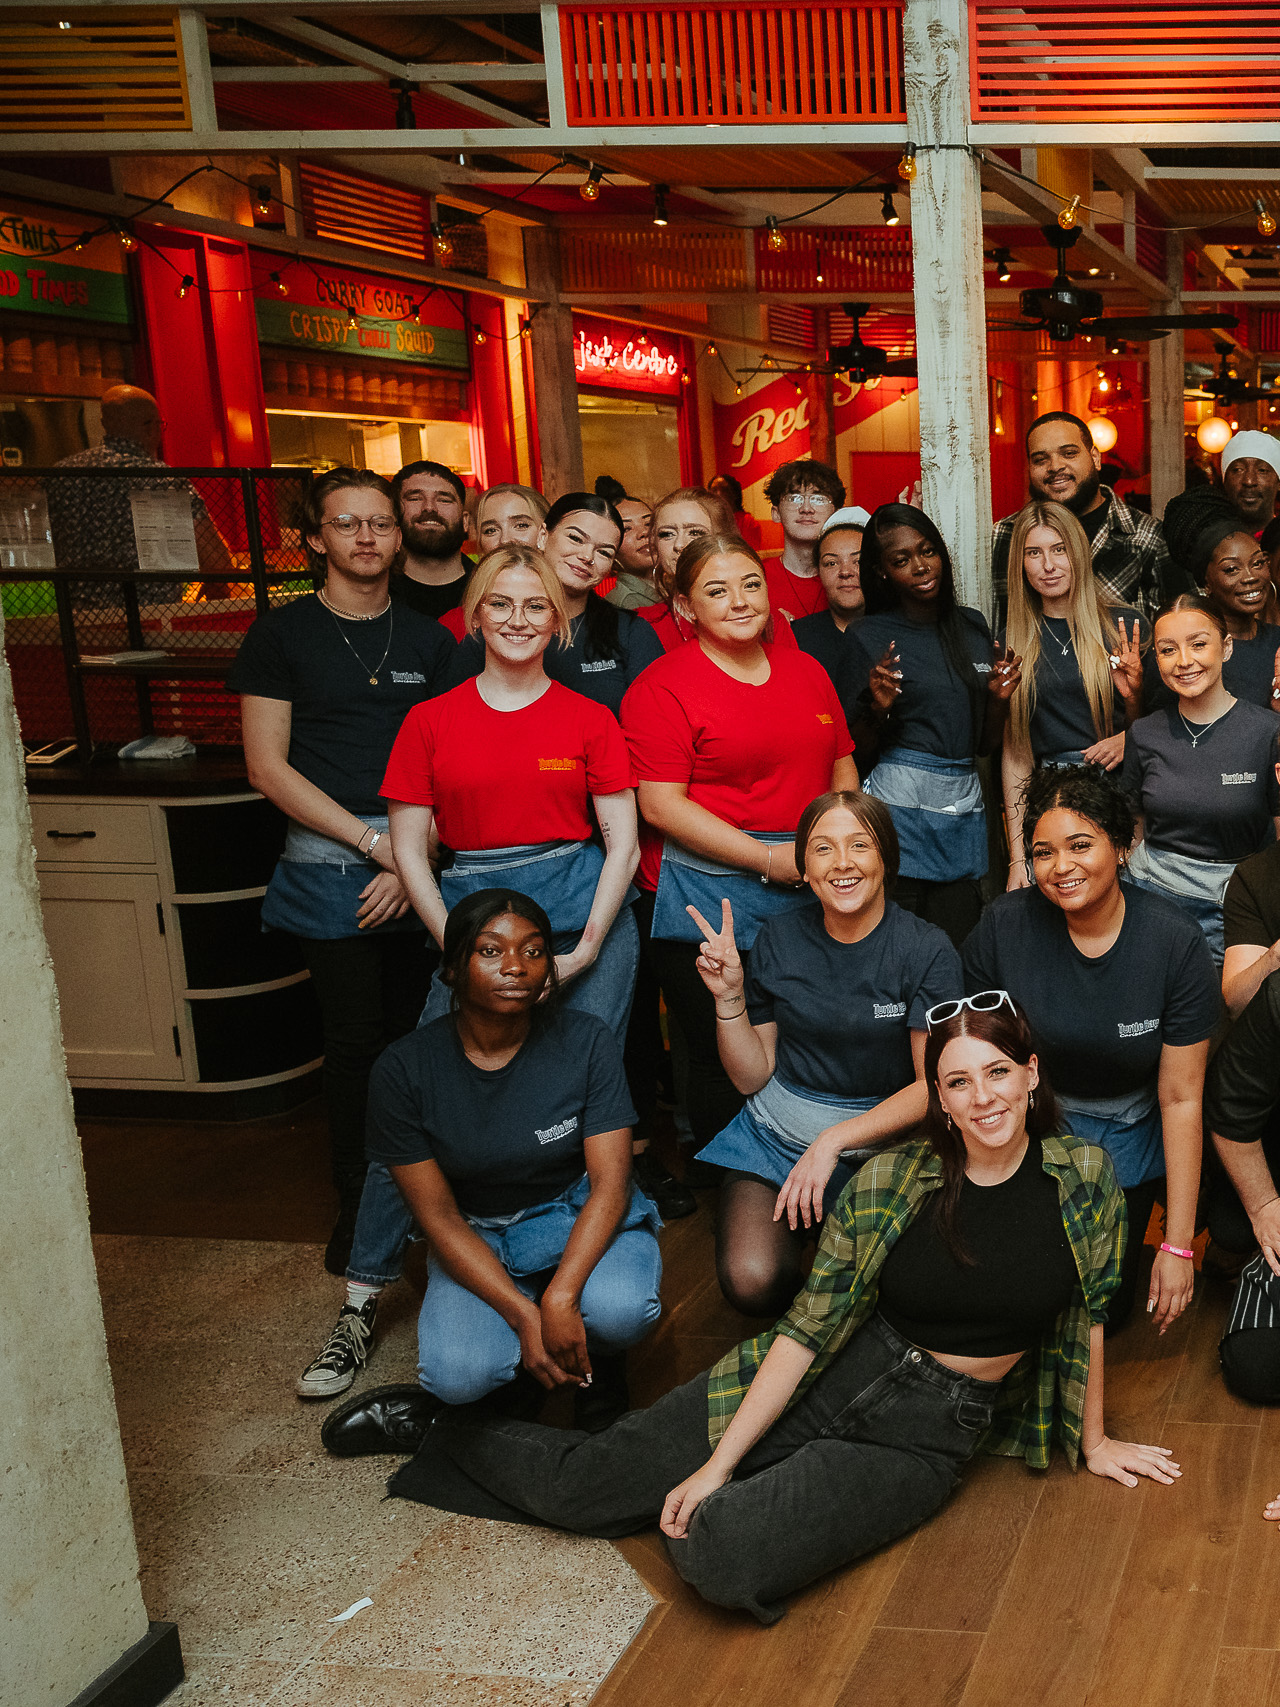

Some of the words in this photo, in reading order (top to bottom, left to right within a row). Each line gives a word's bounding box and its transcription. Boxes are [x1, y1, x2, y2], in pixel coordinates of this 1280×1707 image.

[316, 278, 367, 308] CURRY
[374, 290, 414, 315] GOAT
[290, 310, 349, 344] CRISPY
[622, 342, 678, 376] Centre
[873, 1003, 898, 1014] Turtle
[1117, 1022, 1144, 1034] Turtle
[535, 1125, 565, 1141] Turtle
